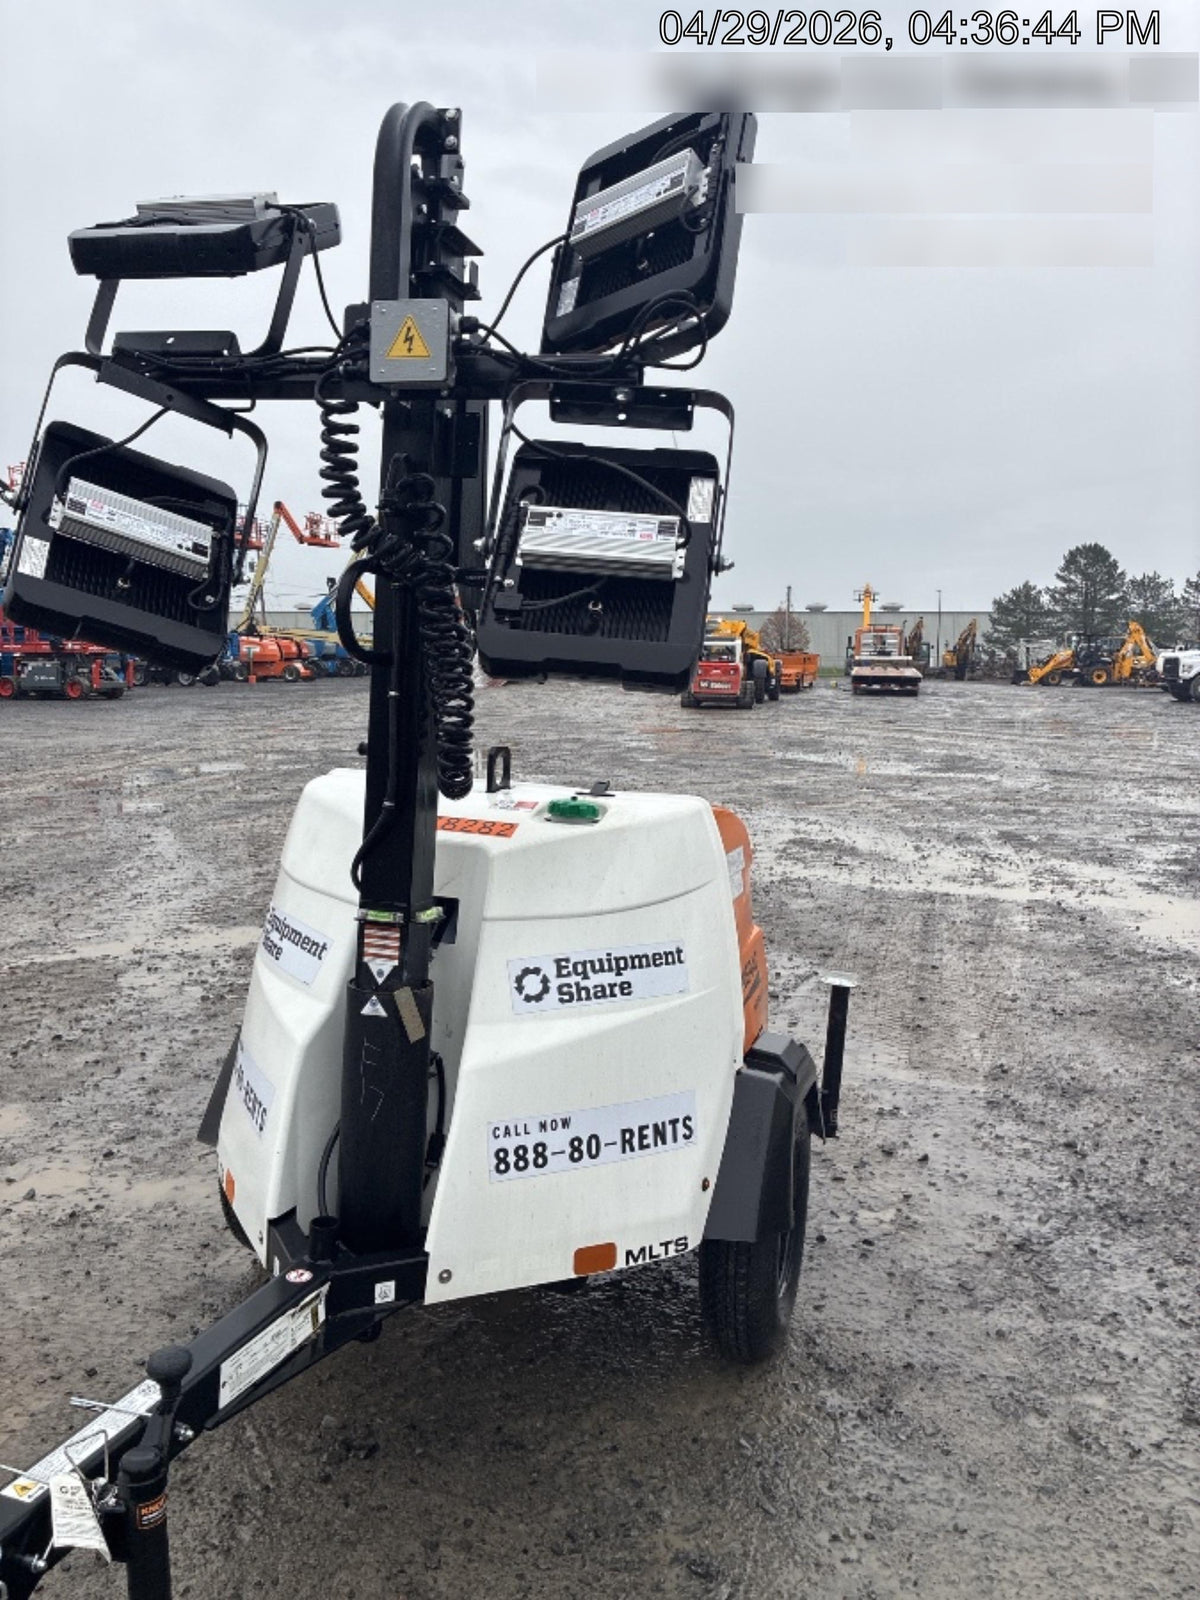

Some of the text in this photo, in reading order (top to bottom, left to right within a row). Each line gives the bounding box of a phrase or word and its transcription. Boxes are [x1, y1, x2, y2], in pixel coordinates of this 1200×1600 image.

[438, 816, 514, 836] 8282
[553, 946, 685, 980] Equipment
[557, 980, 633, 1004] Share
[492, 1117, 572, 1139] CALL NOW
[493, 1115, 694, 1175] 888-80-RENTS
[625, 1236, 689, 1266] MLTS
